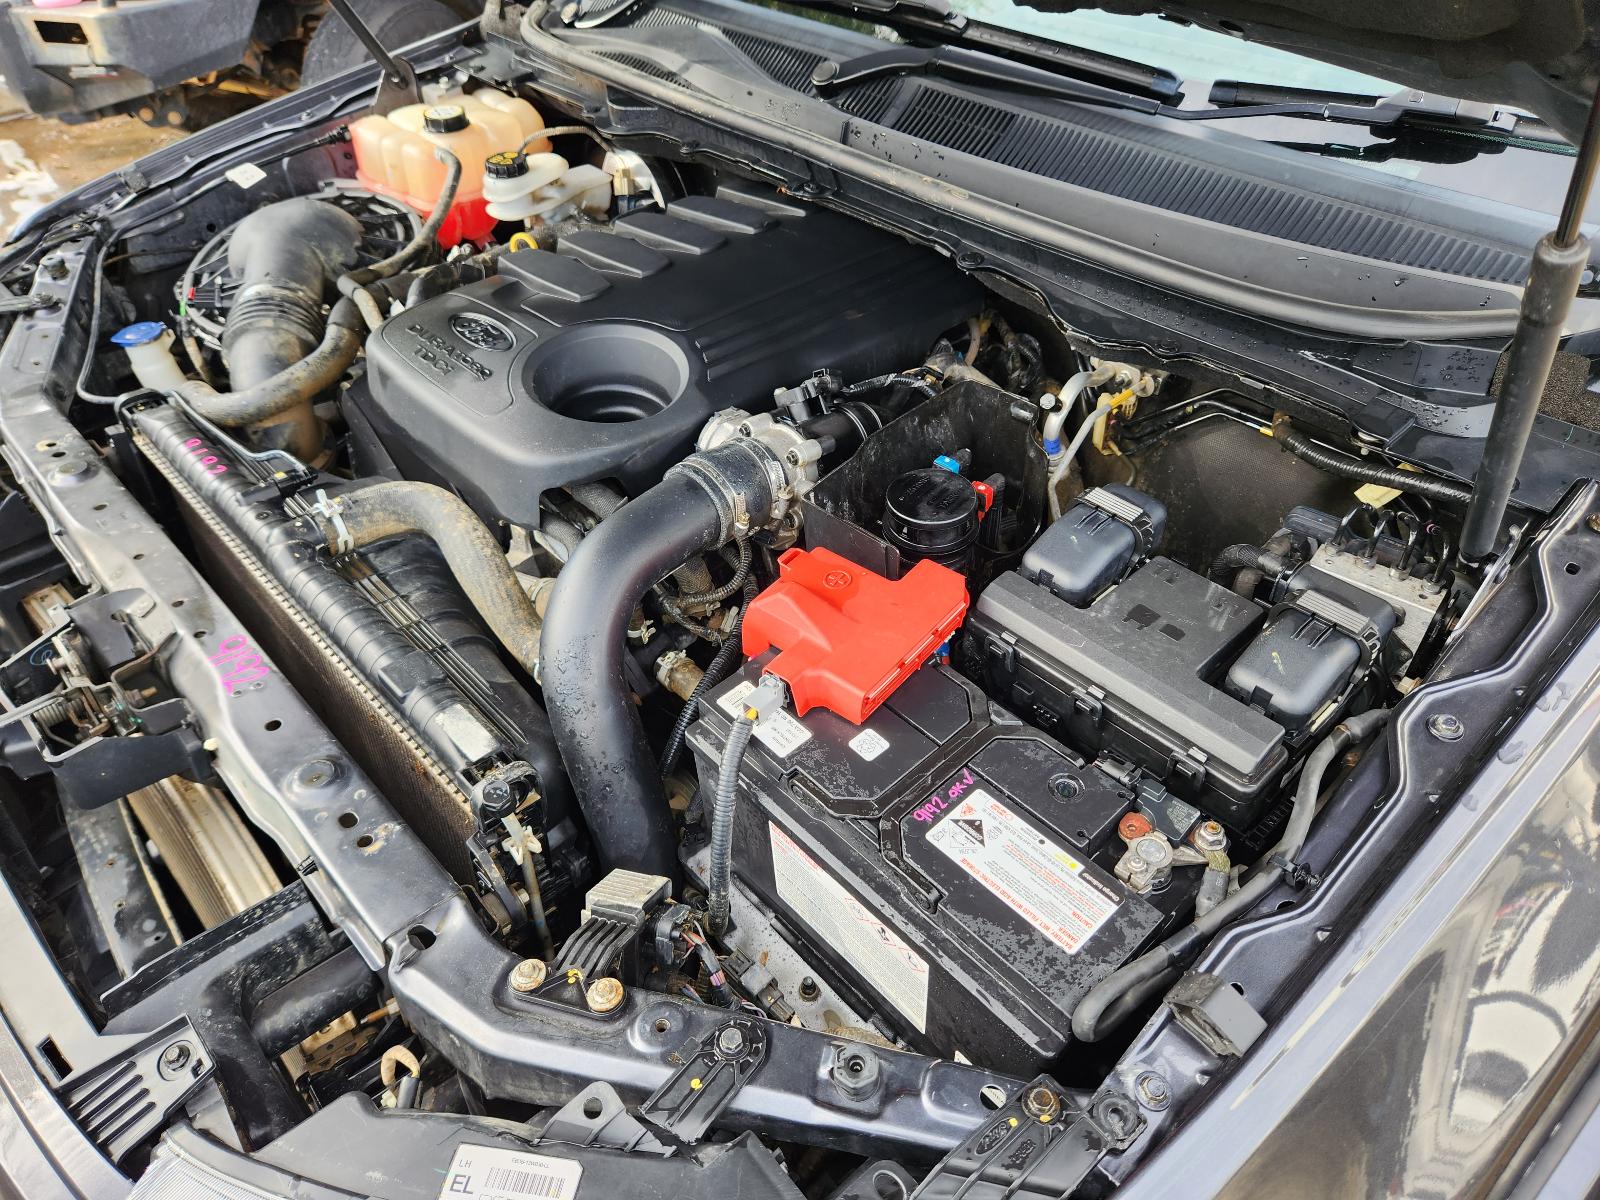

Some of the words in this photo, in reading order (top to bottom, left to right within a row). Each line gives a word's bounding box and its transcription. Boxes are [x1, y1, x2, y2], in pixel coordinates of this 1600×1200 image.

[406, 324, 493, 380] DURATORQ
[207, 634, 270, 695] 9192
[911, 796, 949, 823] 9192
[956, 819, 983, 841] CORROSIVE
[960, 856, 981, 875] STORAGE
[979, 872, 1000, 891] ELECTRIC
[1081, 871, 1103, 890] Indicator
[998, 887, 1012, 900] ACID
[1010, 896, 1024, 910] WITH
[1101, 886, 1120, 902] Charge
[1022, 906, 1039, 922] FILLED
[458, 1159, 473, 1168] LH
[449, 1174, 474, 1195] EL
